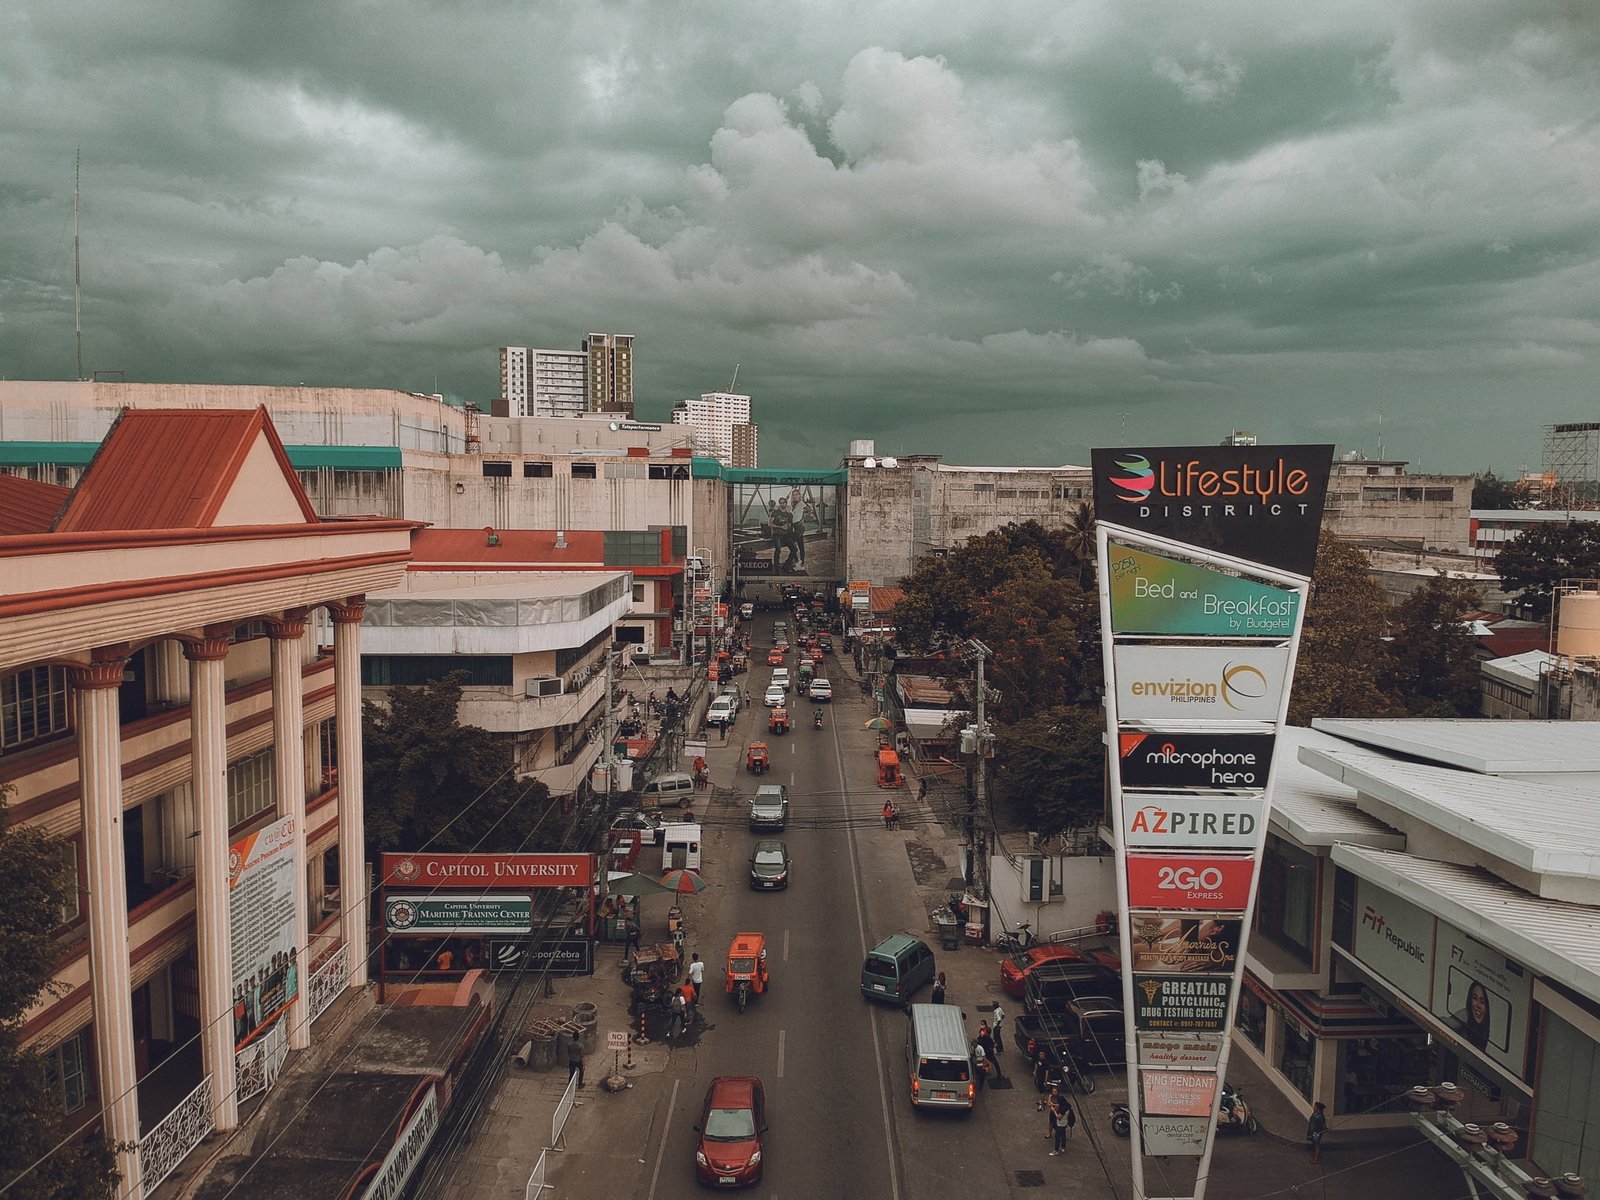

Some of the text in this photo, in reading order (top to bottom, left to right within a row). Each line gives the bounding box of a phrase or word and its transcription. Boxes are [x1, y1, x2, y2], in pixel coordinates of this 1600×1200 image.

[621, 423, 661, 431] Teleperformance
[1160, 458, 1309, 505] Lifestyle
[1140, 504, 1308, 518] DISTRICT
[1135, 577, 1198, 600] Bed and
[1203, 594, 1296, 616] Breakfast
[1229, 617, 1290, 630] by Budgetel
[1131, 678, 1217, 697] envizion
[1170, 695, 1216, 704] PHILIPPINES
[1146, 747, 1256, 769] microphone
[1211, 768, 1255, 784] hero
[1130, 811, 1255, 835] AZPIRED
[426, 861, 579, 876] CAPITOL UNIVERSITY
[1158, 866, 1223, 891] 2GO
[1187, 891, 1224, 900] EXPRESS
[420, 909, 531, 919] MARITIME TRAINING CENTER
[1362, 905, 1385, 935] Fit
[1385, 926, 1425, 964] Republic
[1210, 940, 1235, 967] Spa
[1451, 944, 1464, 963] F7
[1162, 981, 1227, 996] GREATLAB
[1162, 996, 1220, 1007] POLYCLINIC
[1141, 1006, 1223, 1018] DRUG TESTING CENTER
[1143, 1042, 1180, 1051] mango
[1149, 1052, 1207, 1062] healthy dessert
[1145, 1074, 1215, 1089] ZING PENDANT
[1154, 1124, 1195, 1135] JABAGAT
